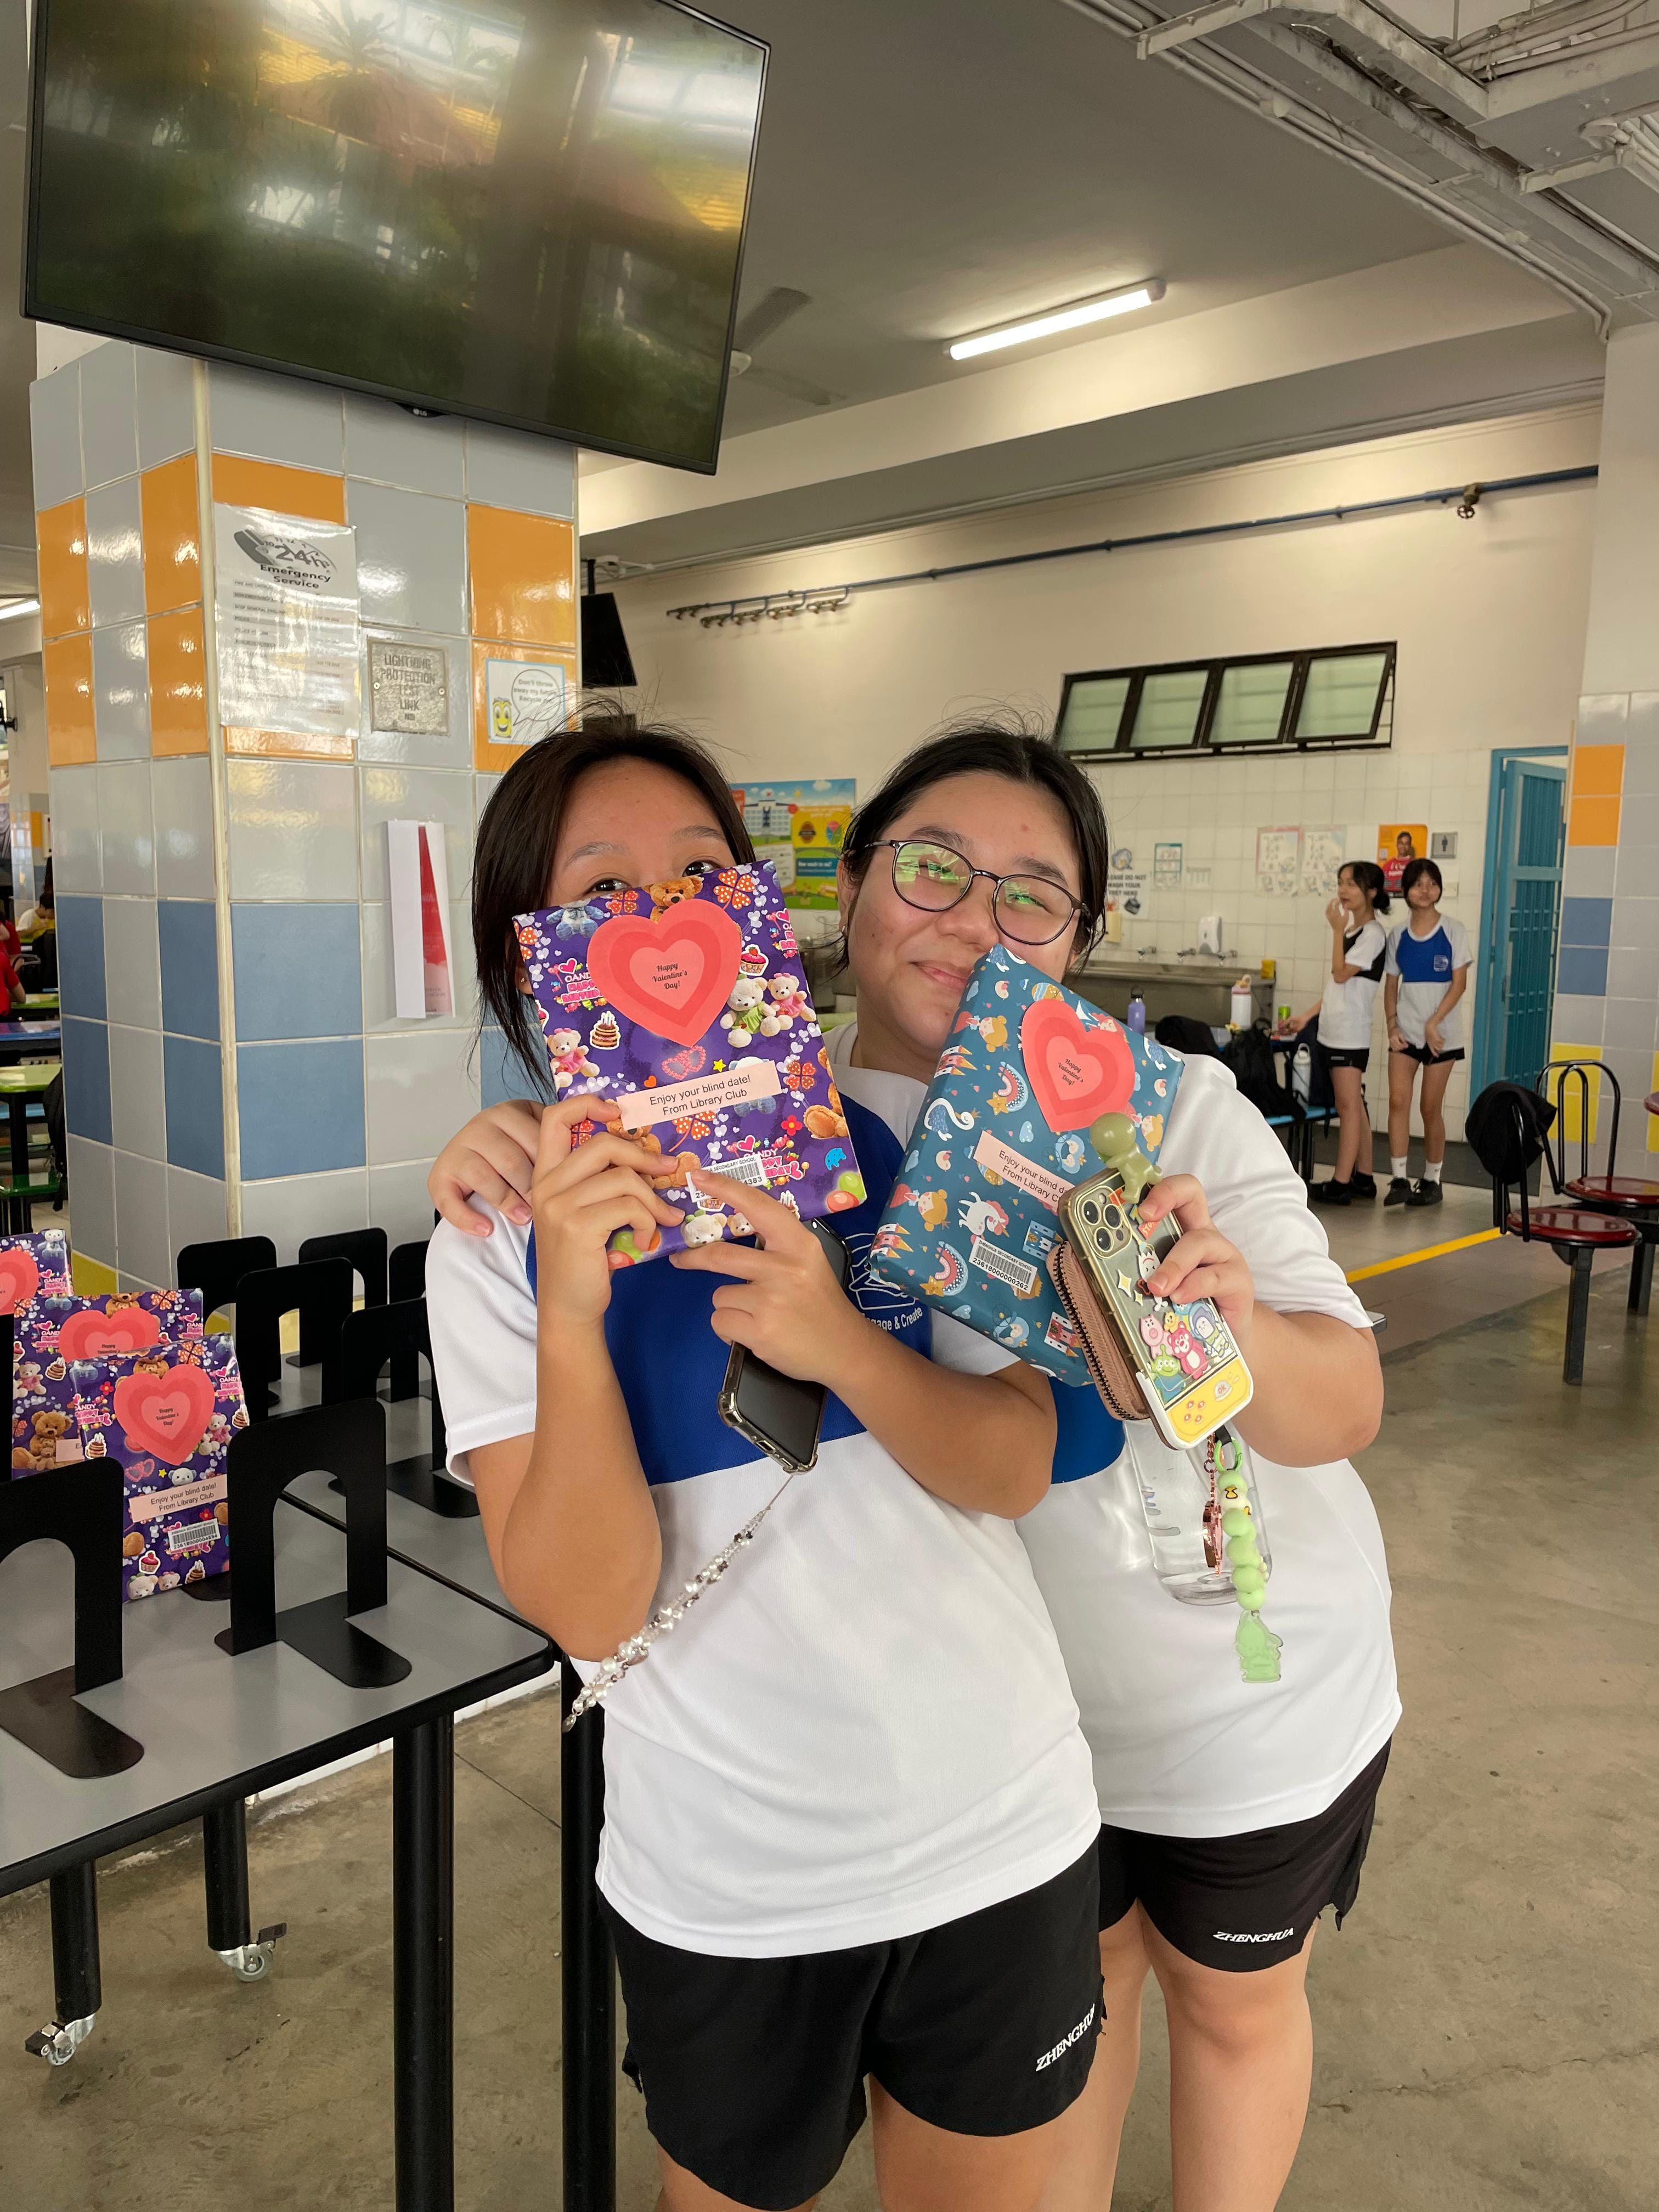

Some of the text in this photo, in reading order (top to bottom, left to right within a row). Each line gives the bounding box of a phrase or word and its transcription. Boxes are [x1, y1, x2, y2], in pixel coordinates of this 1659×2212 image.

[260, 564, 331, 582] Emergency
[274, 575, 319, 589] Service
[384, 654, 431, 669] LIGHTNING
[381, 668, 435, 684] PROTECTION
[399, 698, 420, 710] LINK
[656, 963, 678, 972] Happy
[565, 972, 591, 982] CAND
[652, 970, 687, 982] Valentine's
[664, 980, 680, 990] Day!
[1057, 1062, 1084, 1083] Valentine's
[1065, 1058, 1081, 1073] Happy
[1062, 1074, 1075, 1085] Day!
[650, 1074, 751, 1105] Enjoy your blind date!
[663, 1089, 747, 1115] From Library Club
[714, 1161, 738, 1171] SECONDARY
[999, 1150, 1020, 1169] Enjoy
[1020, 1165, 1038, 1178] your
[1039, 1173, 1058, 1190] blind
[1002, 1165, 1022, 1182] From
[1024, 1178, 1050, 1199] Library
[978, 1240, 1032, 1272] ZHENGHUA SECONDARY SCHOOL
[973, 1257, 1029, 1290] 23618000000262
[894, 1316, 900, 1329] &
[901, 1307, 923, 1327] Create
[1218, 1384, 1227, 1395] OK
[155, 1413, 179, 1421] Valentine's
[151, 1483, 217, 1505] Enjoy your blind date!
[159, 1492, 215, 1511] From Library Club
[1213, 1927, 1294, 1943] ZHENGHUA
[1035, 2003, 1095, 2072] ZHENGHU
